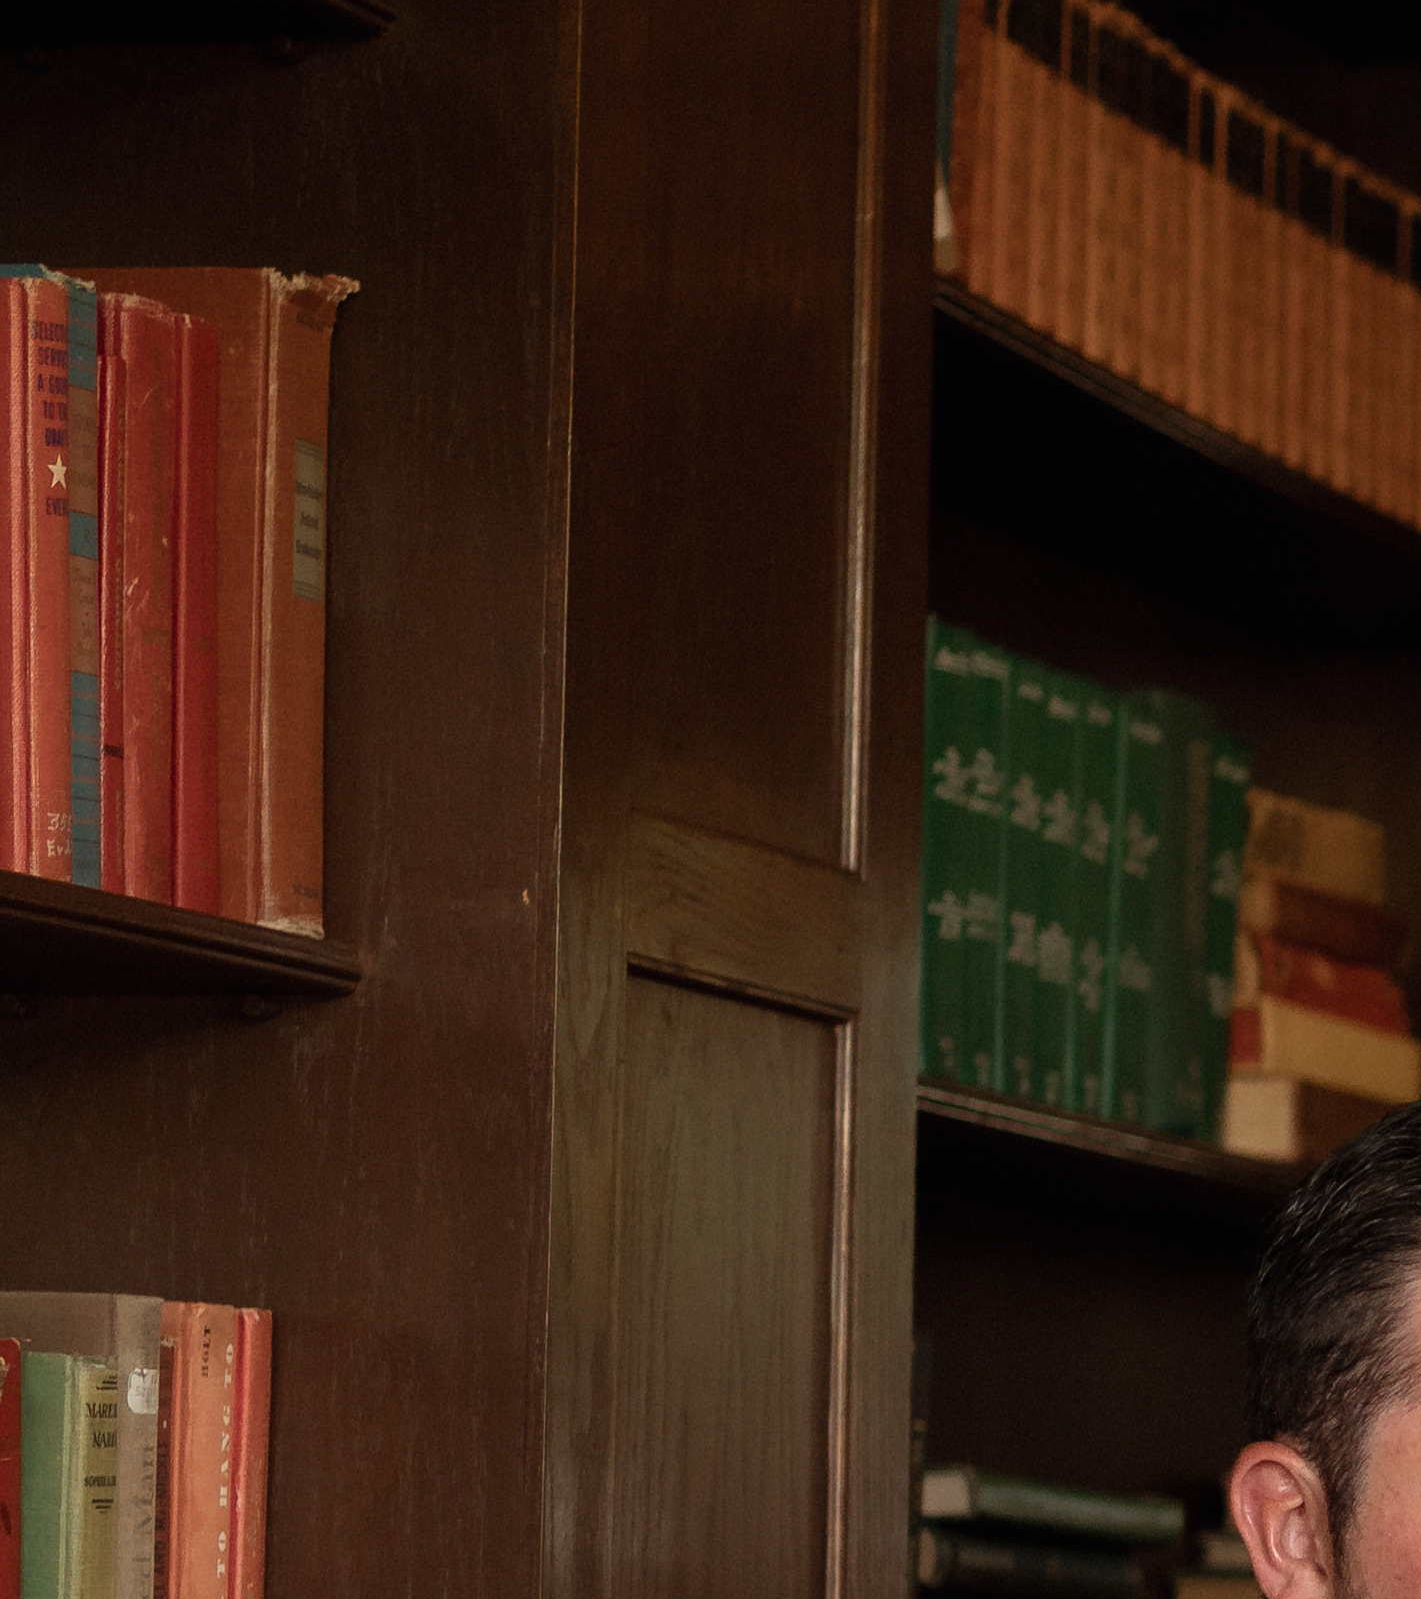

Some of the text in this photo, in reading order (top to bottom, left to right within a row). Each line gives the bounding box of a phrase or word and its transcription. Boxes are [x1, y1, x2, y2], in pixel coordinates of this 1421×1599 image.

[201, 1323, 212, 1378] HOLT
[224, 1342, 235, 1389] TO
[218, 1404, 231, 1508] HANG
[134, 1443, 154, 1537] Man
[154, 1540, 165, 1576] AND
[216, 1530, 228, 1579] TO
